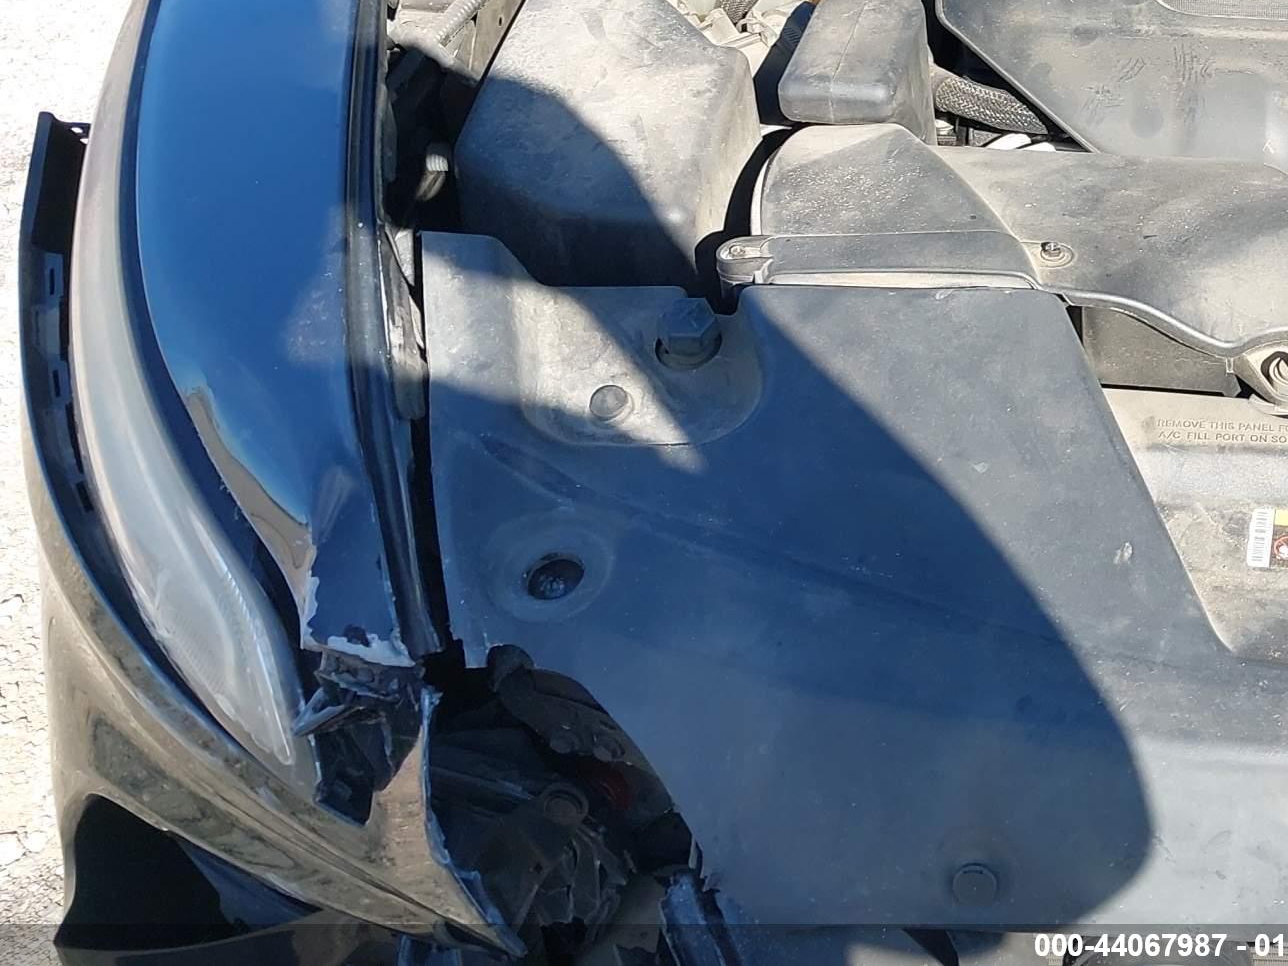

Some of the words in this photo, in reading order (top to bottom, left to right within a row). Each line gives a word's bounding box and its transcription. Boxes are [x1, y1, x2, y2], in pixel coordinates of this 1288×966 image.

[1157, 418, 1205, 429] REMOVE
[1209, 420, 1235, 430] THIS
[1238, 422, 1275, 432] PANEL
[1158, 430, 1180, 440] A/C
[1186, 431, 1210, 441] FILL
[1215, 432, 1246, 442] PORT
[1250, 433, 1268, 443] ON
